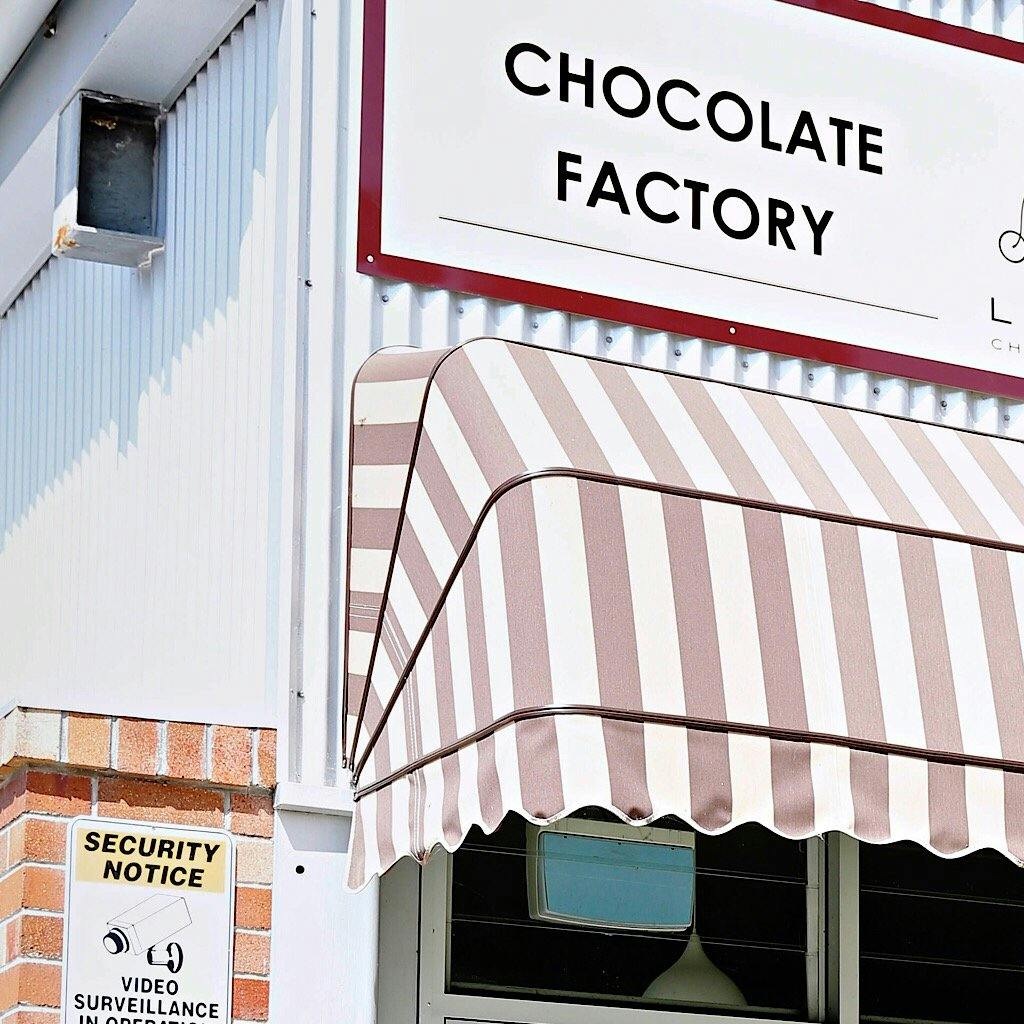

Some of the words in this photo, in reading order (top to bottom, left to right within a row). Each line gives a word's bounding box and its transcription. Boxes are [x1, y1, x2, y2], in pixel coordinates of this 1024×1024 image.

[505, 42, 883, 176] CHOCOLATE
[556, 150, 834, 256] FACTORY
[84, 831, 221, 863] SECURITY
[103, 860, 206, 888] NOTICE
[121, 976, 179, 996] VIDEO
[74, 993, 219, 1019] SURVEILLANCE
